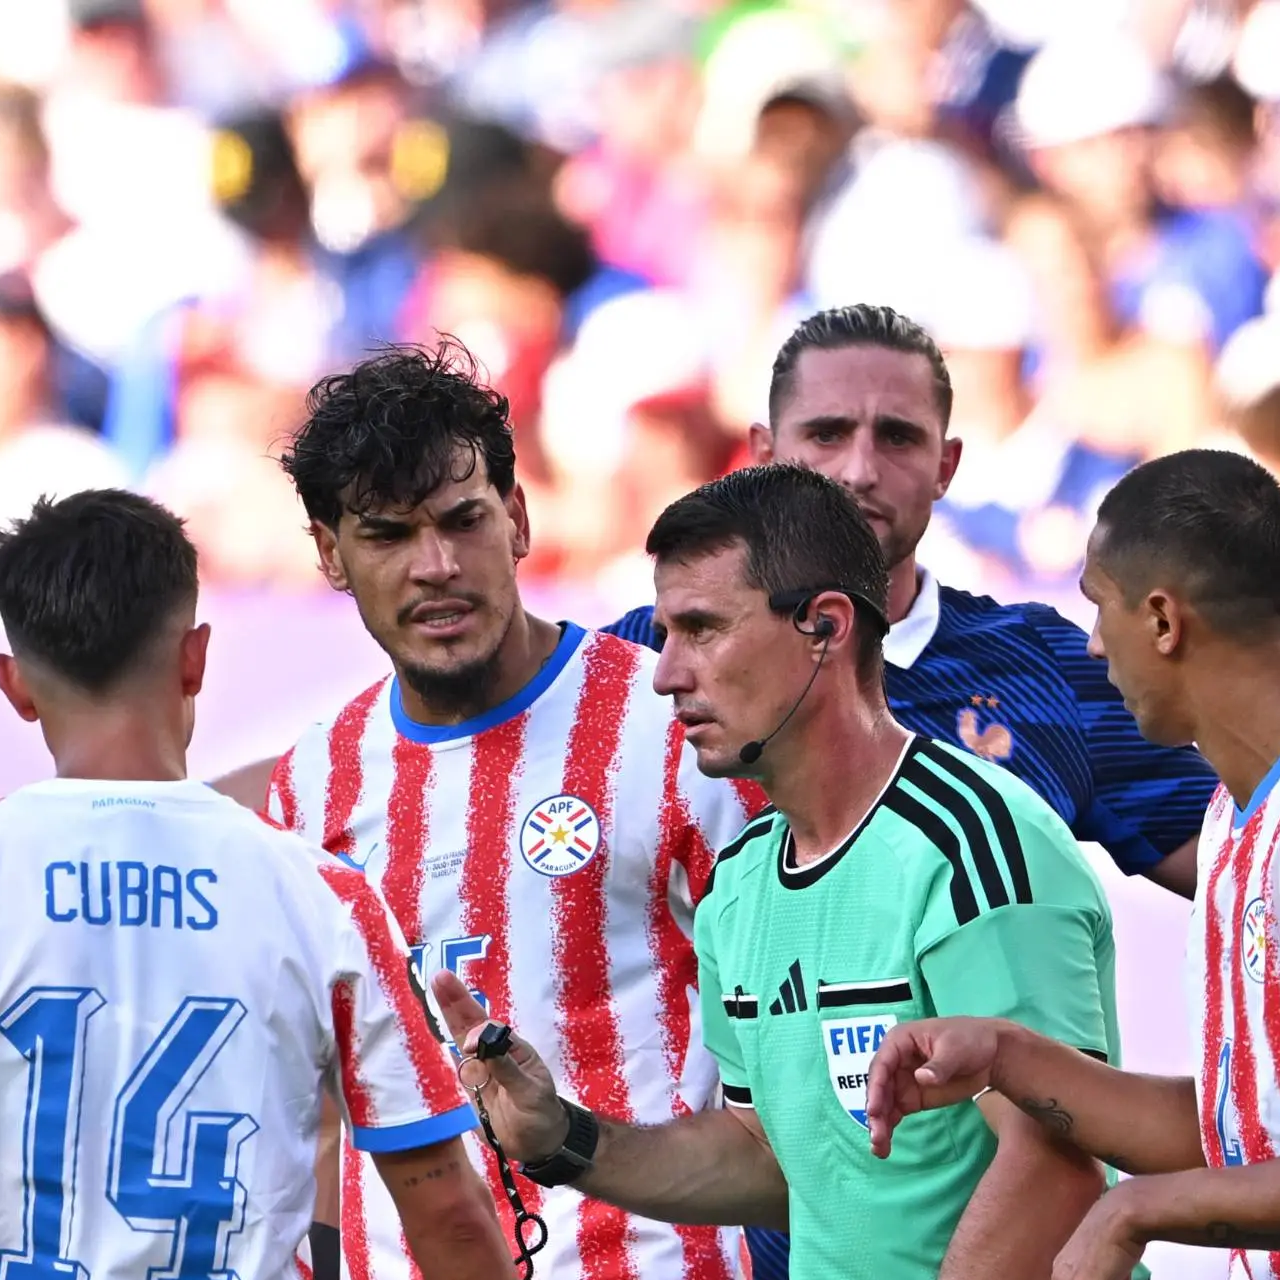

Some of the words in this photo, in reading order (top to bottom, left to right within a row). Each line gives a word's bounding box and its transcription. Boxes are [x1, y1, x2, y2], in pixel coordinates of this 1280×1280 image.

[92, 797, 156, 810] PARAGUAY
[548, 801, 573, 814] APF
[540, 861, 577, 872] PARAGUAY
[44, 860, 219, 932] CUBAS
